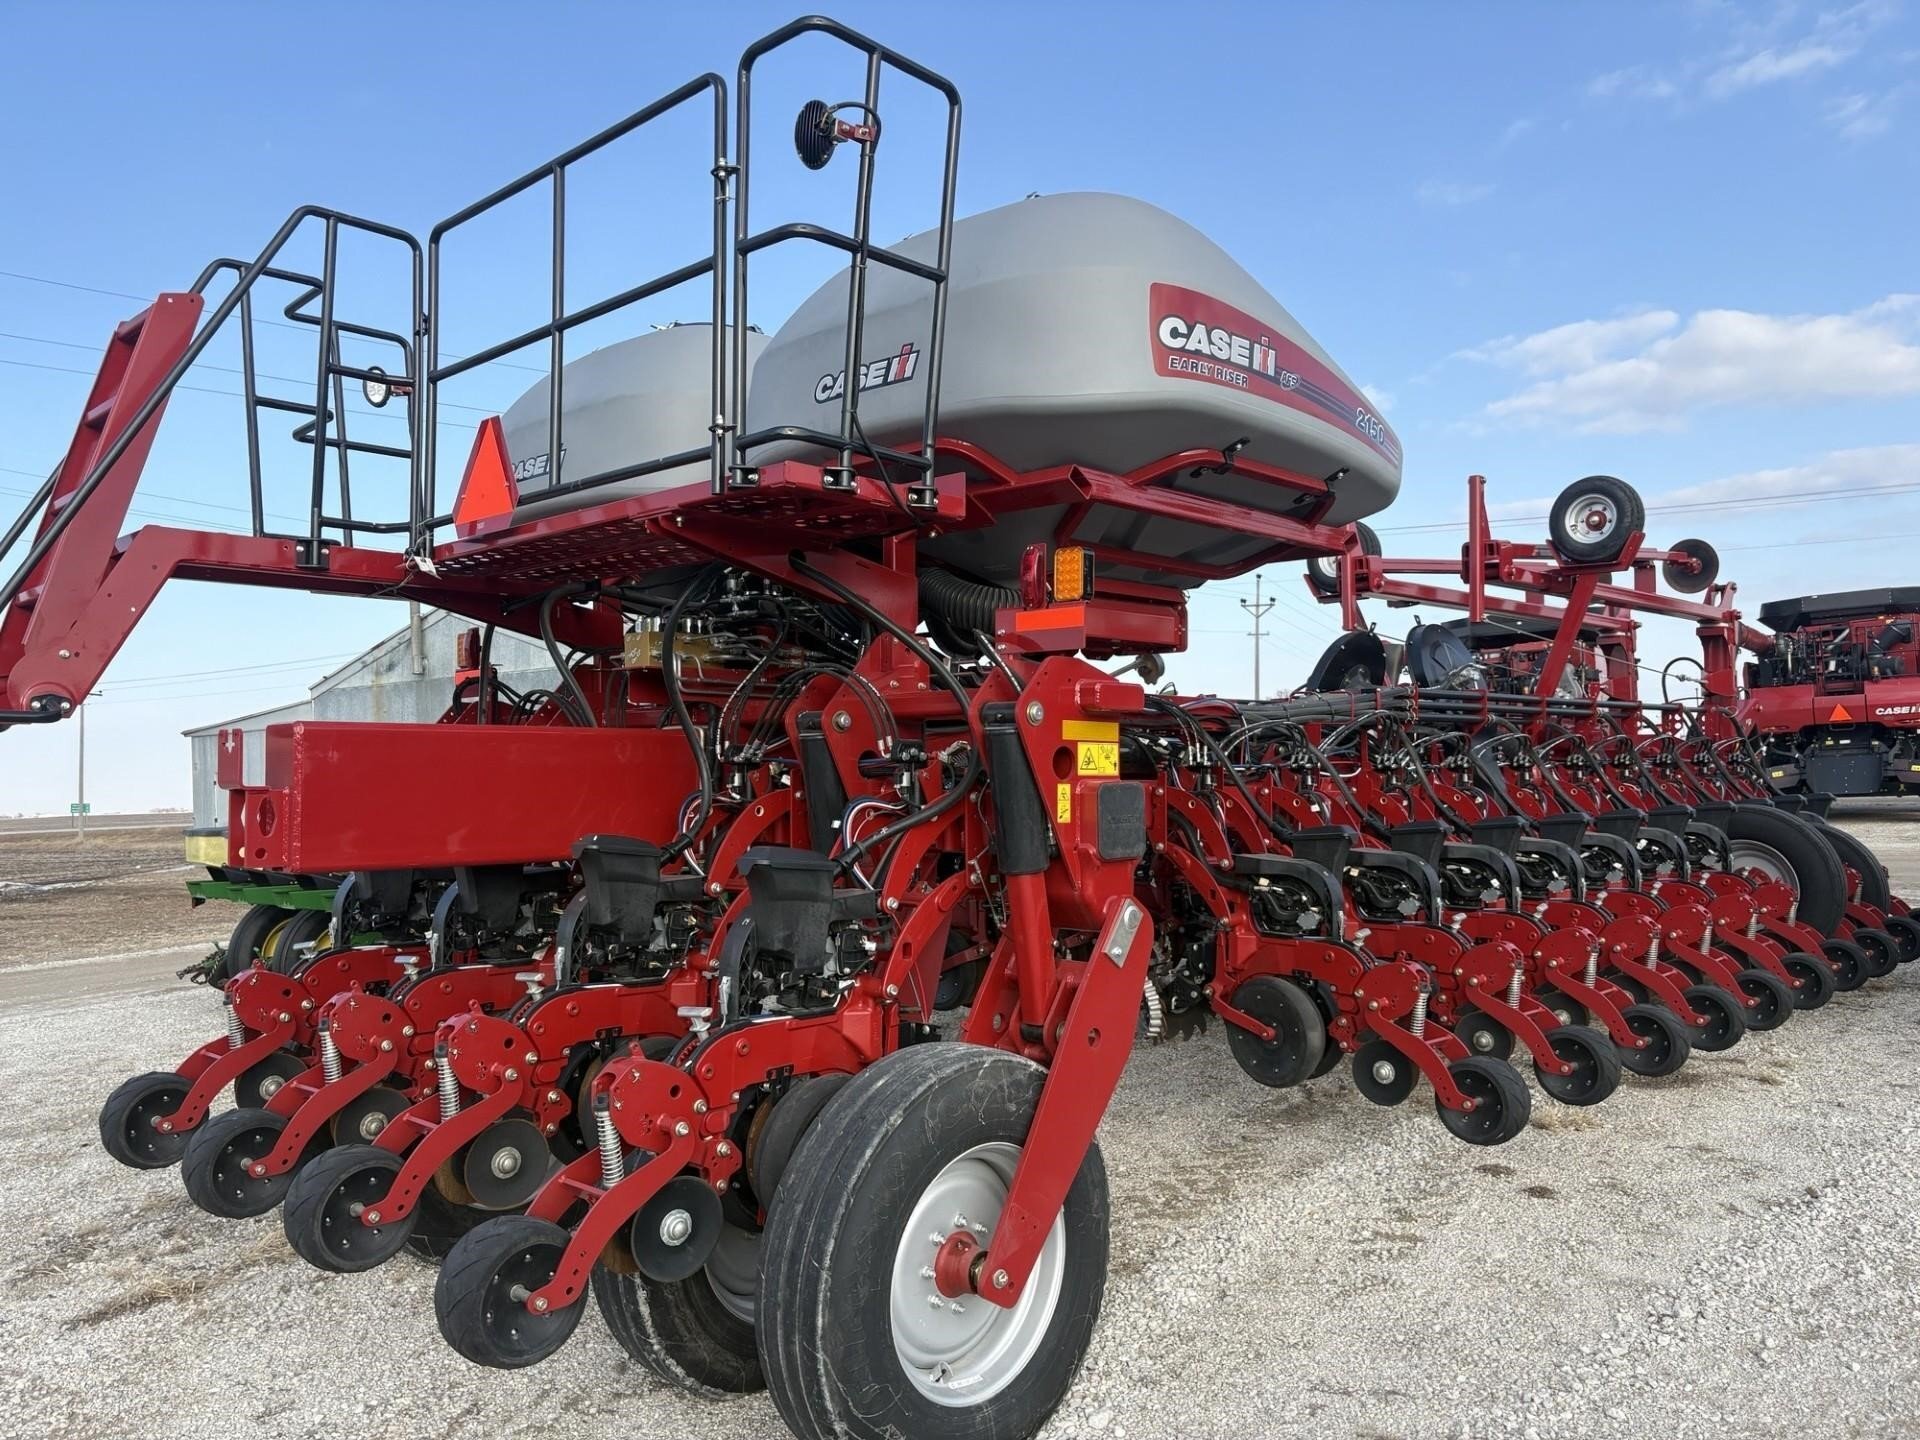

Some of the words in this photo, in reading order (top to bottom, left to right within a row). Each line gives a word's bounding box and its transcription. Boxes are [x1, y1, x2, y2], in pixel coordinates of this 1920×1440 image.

[1158, 316, 1251, 368] CASE
[1168, 355, 1215, 378] EARLY
[1214, 365, 1249, 389] RISER
[1280, 370, 1299, 388] AFS
[1355, 407, 1385, 446] 2150
[512, 455, 549, 482] ASE
[1875, 706, 1911, 716] CASE
